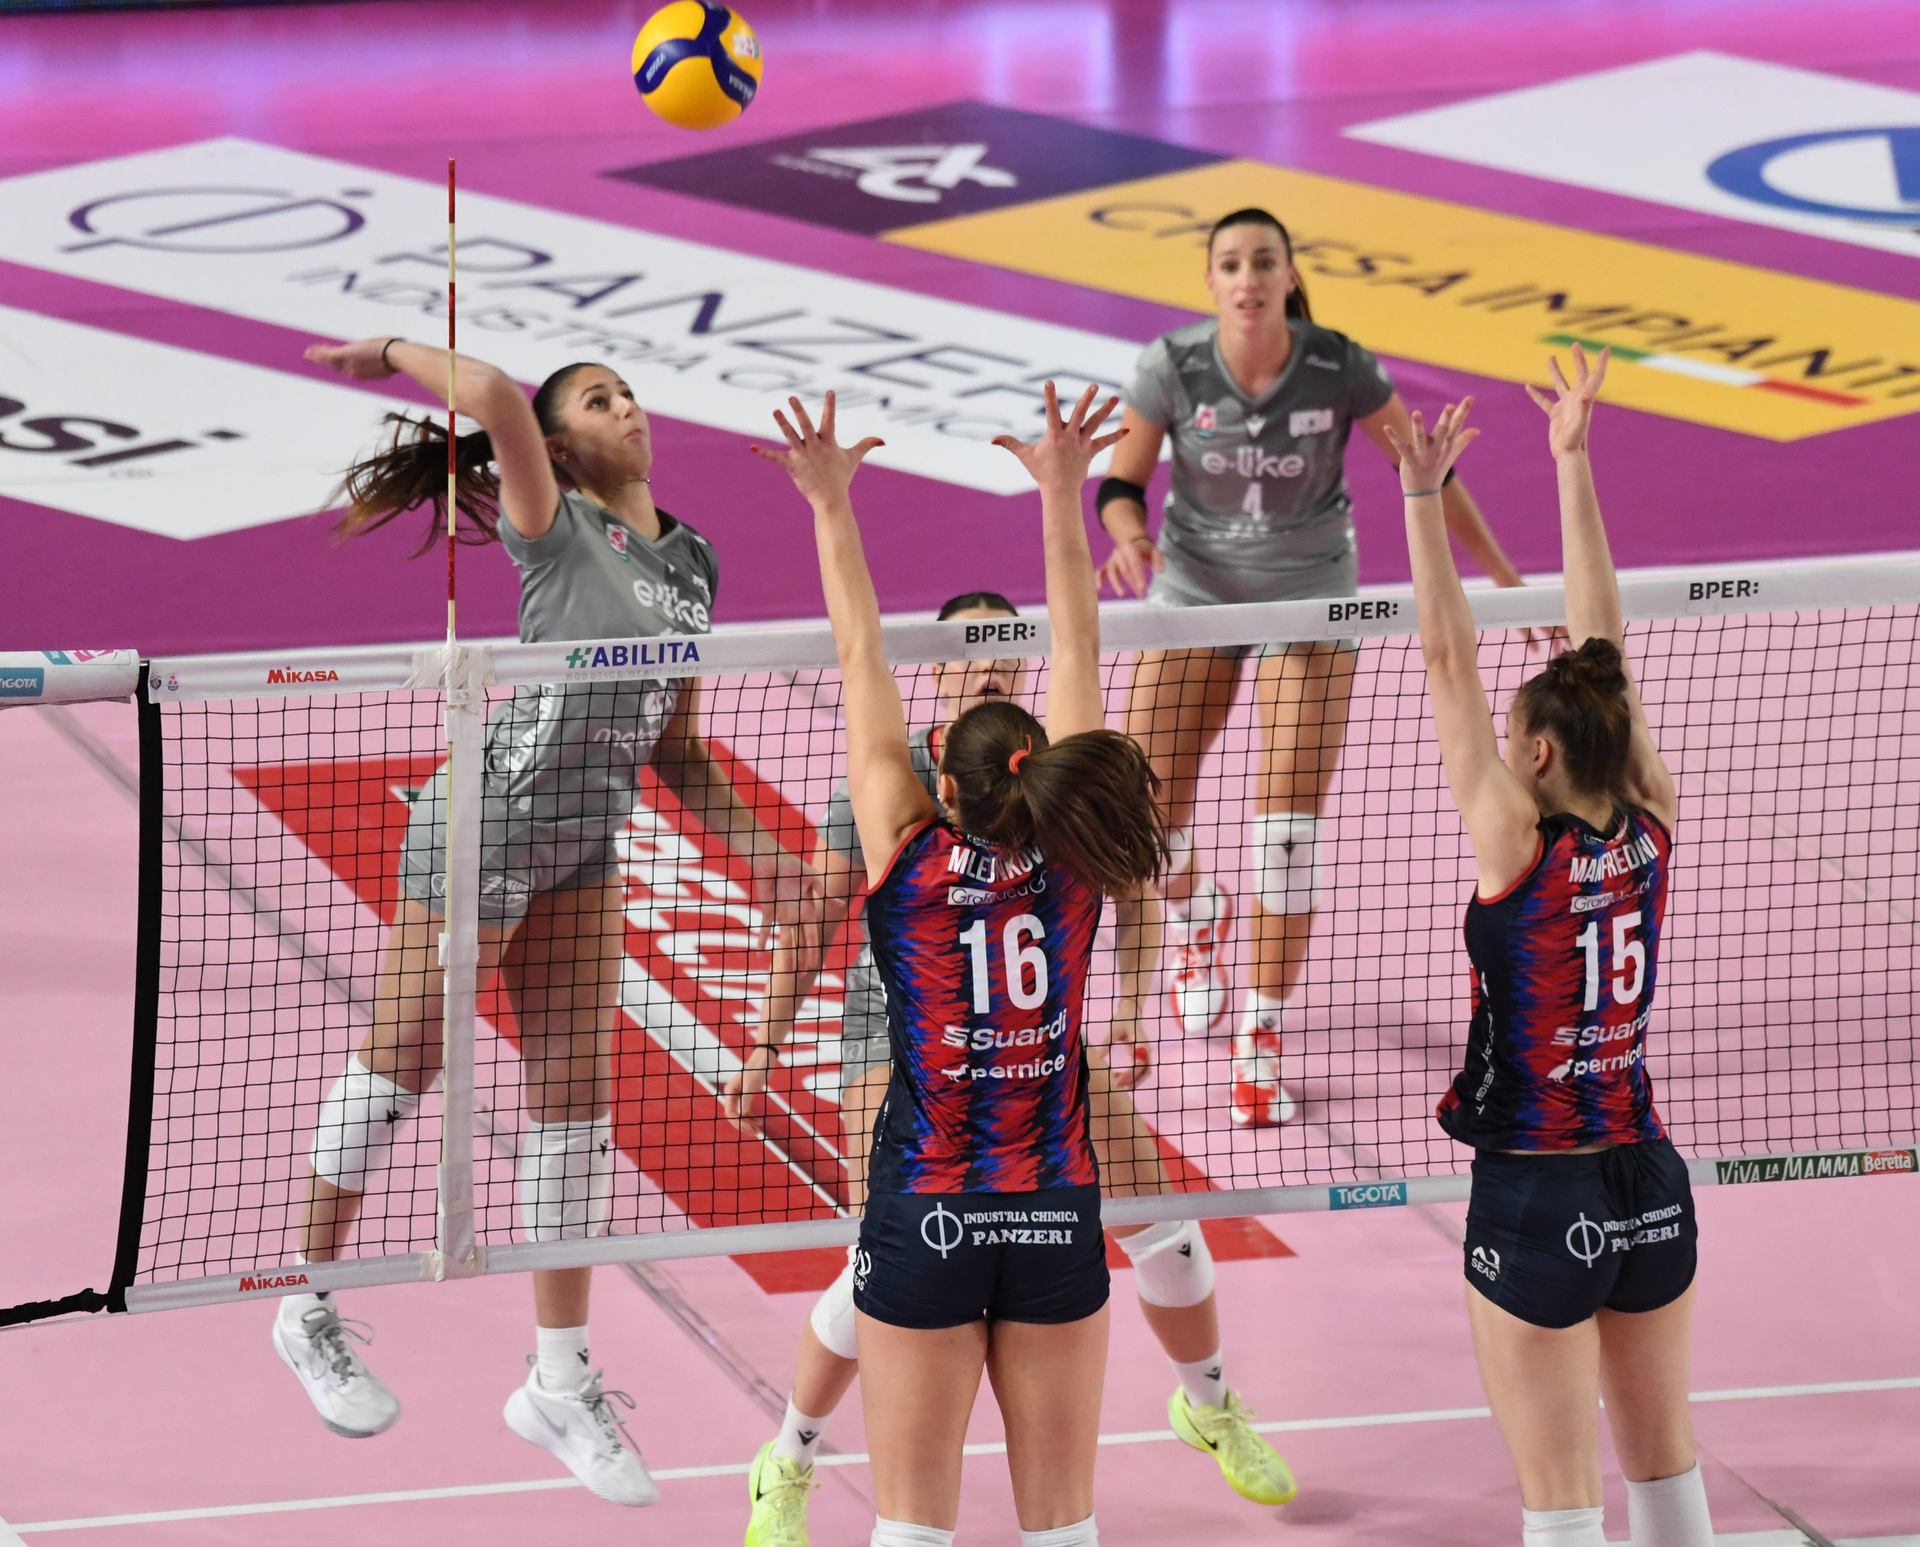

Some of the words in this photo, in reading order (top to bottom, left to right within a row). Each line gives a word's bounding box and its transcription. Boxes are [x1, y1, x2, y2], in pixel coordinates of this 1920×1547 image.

[373, 235, 1128, 426] PANZER
[1201, 446, 1305, 478] e-like
[1242, 482, 1265, 521] 4
[1690, 580, 1759, 600] BPER:
[1328, 602, 1398, 622] BPER:
[965, 624, 1036, 644] BPER:
[566, 671, 623, 680] ROBOTICS
[959, 914, 1049, 1014] 16
[1575, 911, 1646, 1012] 15
[971, 1008, 1067, 1050] Suardi
[1579, 1003, 1652, 1046] Suard
[971, 1054, 1066, 1080] pernice
[1573, 1043, 1643, 1077] pernice
[1764, 1164, 1779, 1181] LA
[1782, 1155, 1860, 1182] MAMMA
[1864, 1154, 1912, 1173] Beretta
[963, 1211, 1029, 1225] INDUSTRIA
[1031, 1211, 1079, 1223] CHIMICA
[1642, 1203, 1682, 1224] CHIMICA
[972, 1229, 1073, 1246] PANZERI
[1611, 1223, 1680, 1252] PAZERI
[1471, 1257, 1497, 1282] SEAS
